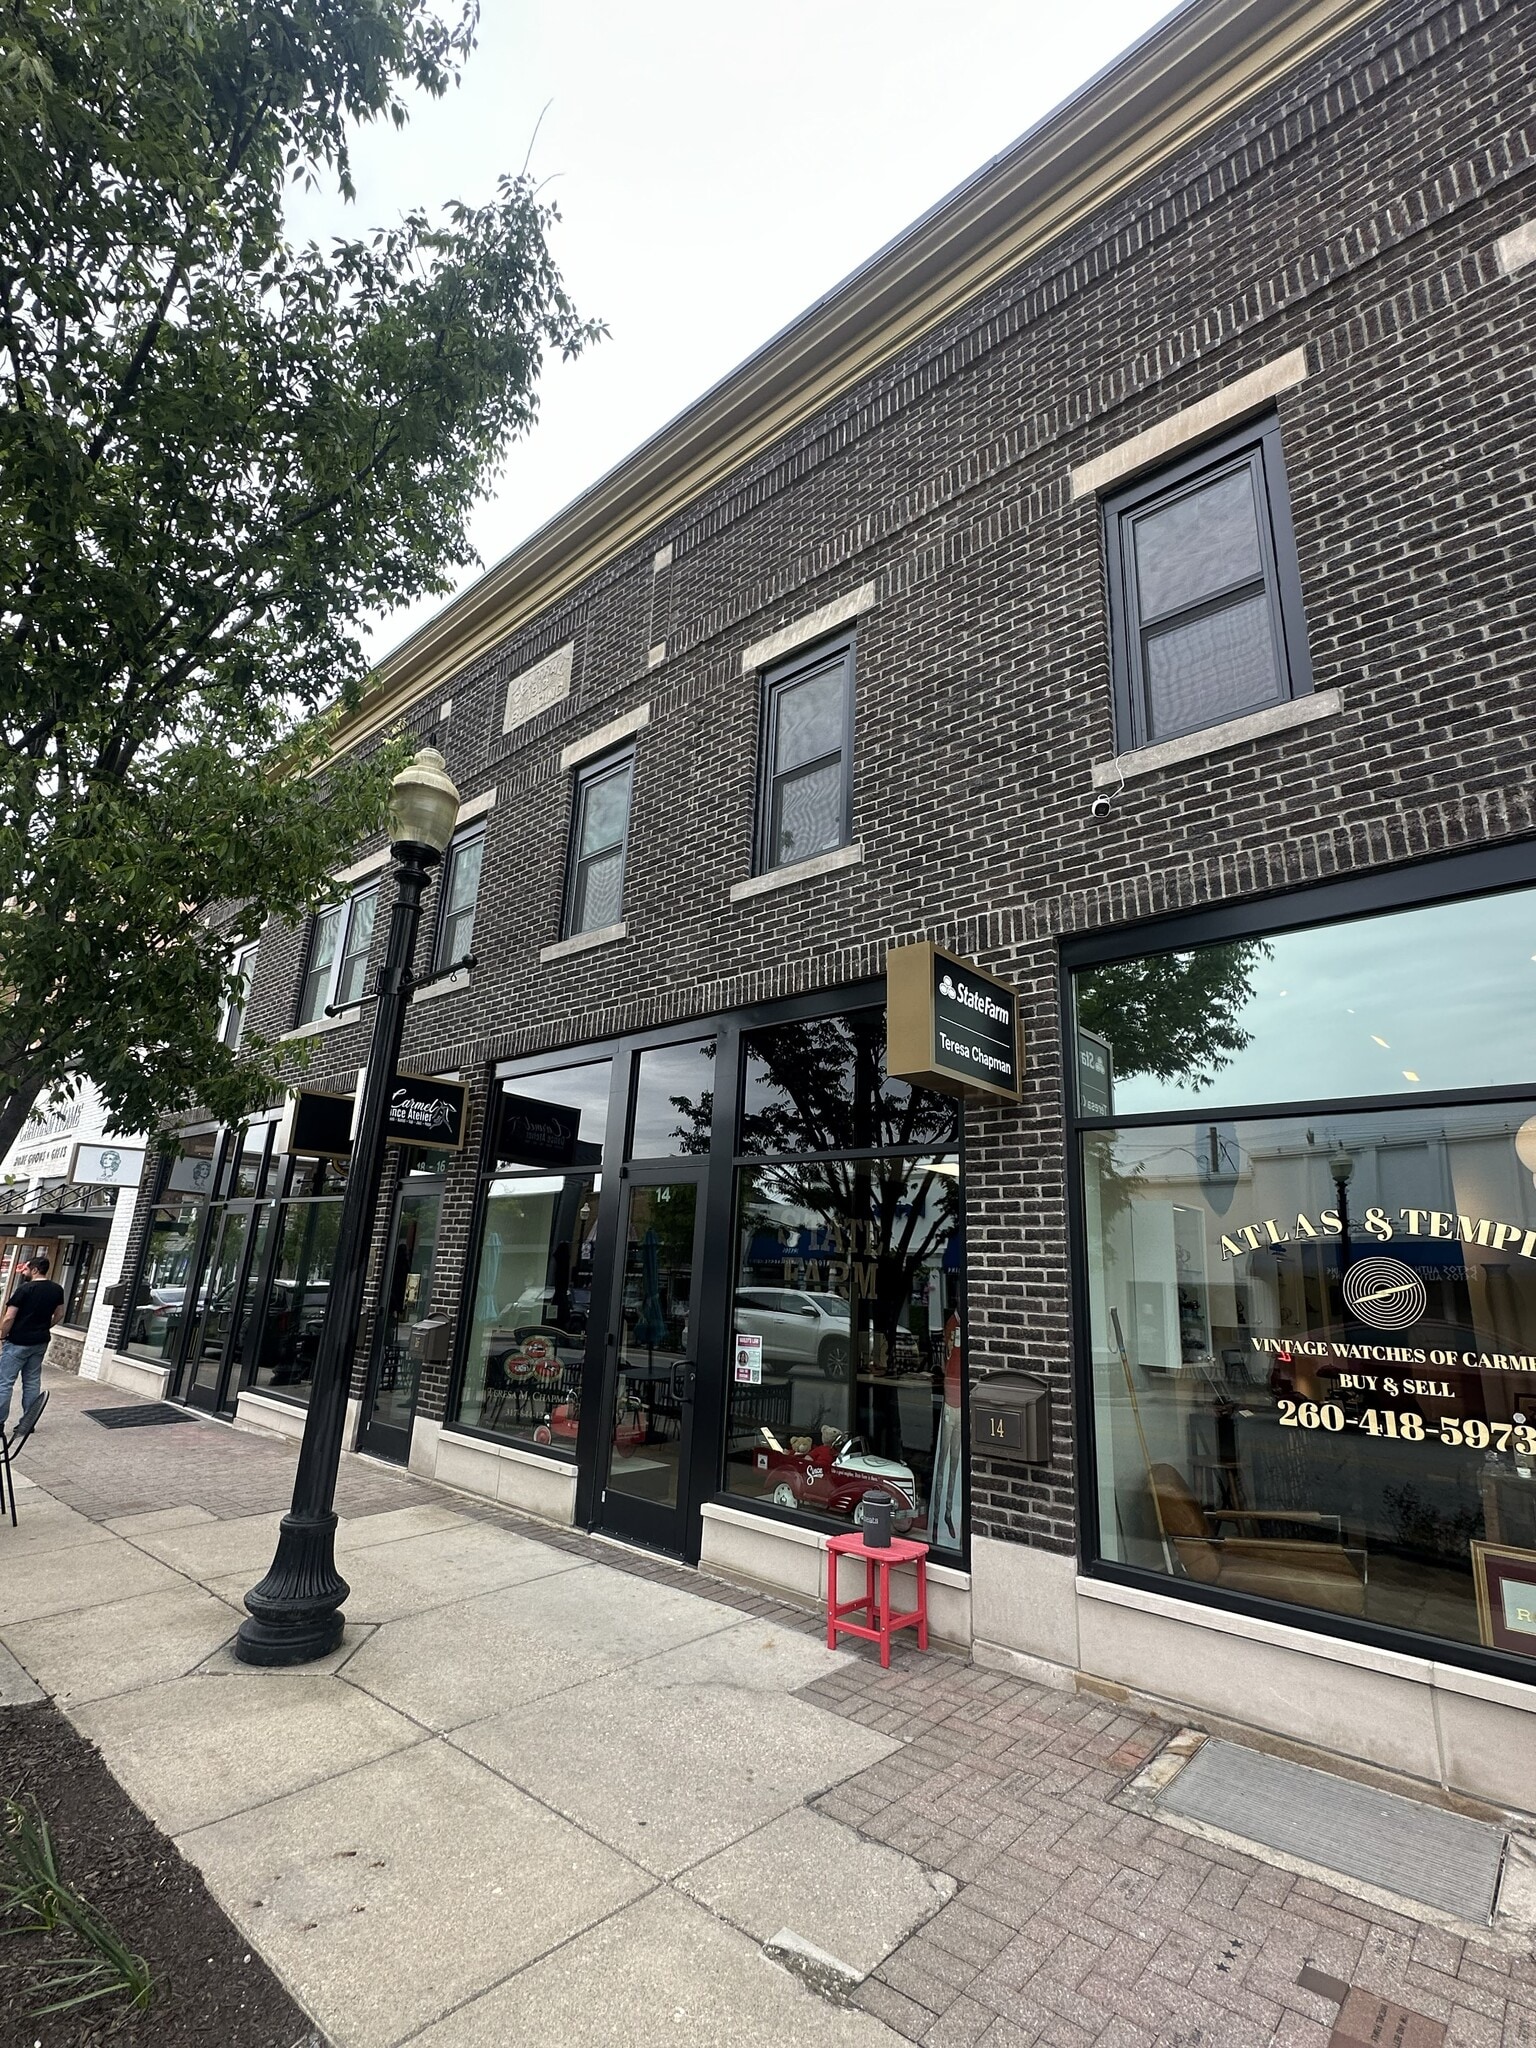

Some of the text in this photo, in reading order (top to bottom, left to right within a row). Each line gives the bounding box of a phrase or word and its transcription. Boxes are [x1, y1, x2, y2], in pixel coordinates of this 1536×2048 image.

[939, 1031, 1012, 1076] Teresa Chapman
[391, 1088, 439, 1113] Carmel
[407, 1108, 433, 1122] Atelier
[437, 1160, 446, 1172] 16
[655, 1186, 671, 1203] 14
[1219, 1208, 1343, 1262] ATLAS
[1364, 1206, 1393, 1242] &
[781, 1256, 879, 1300] FARM
[1251, 1337, 1329, 1357] VINTAGE
[1330, 1342, 1425, 1364] WATCHES
[1428, 1349, 1458, 1366] OF
[1338, 1373, 1456, 1398] BUY & SELL
[989, 1417, 1005, 1438] 14
[1277, 1399, 1536, 1457] 260-418-5973
